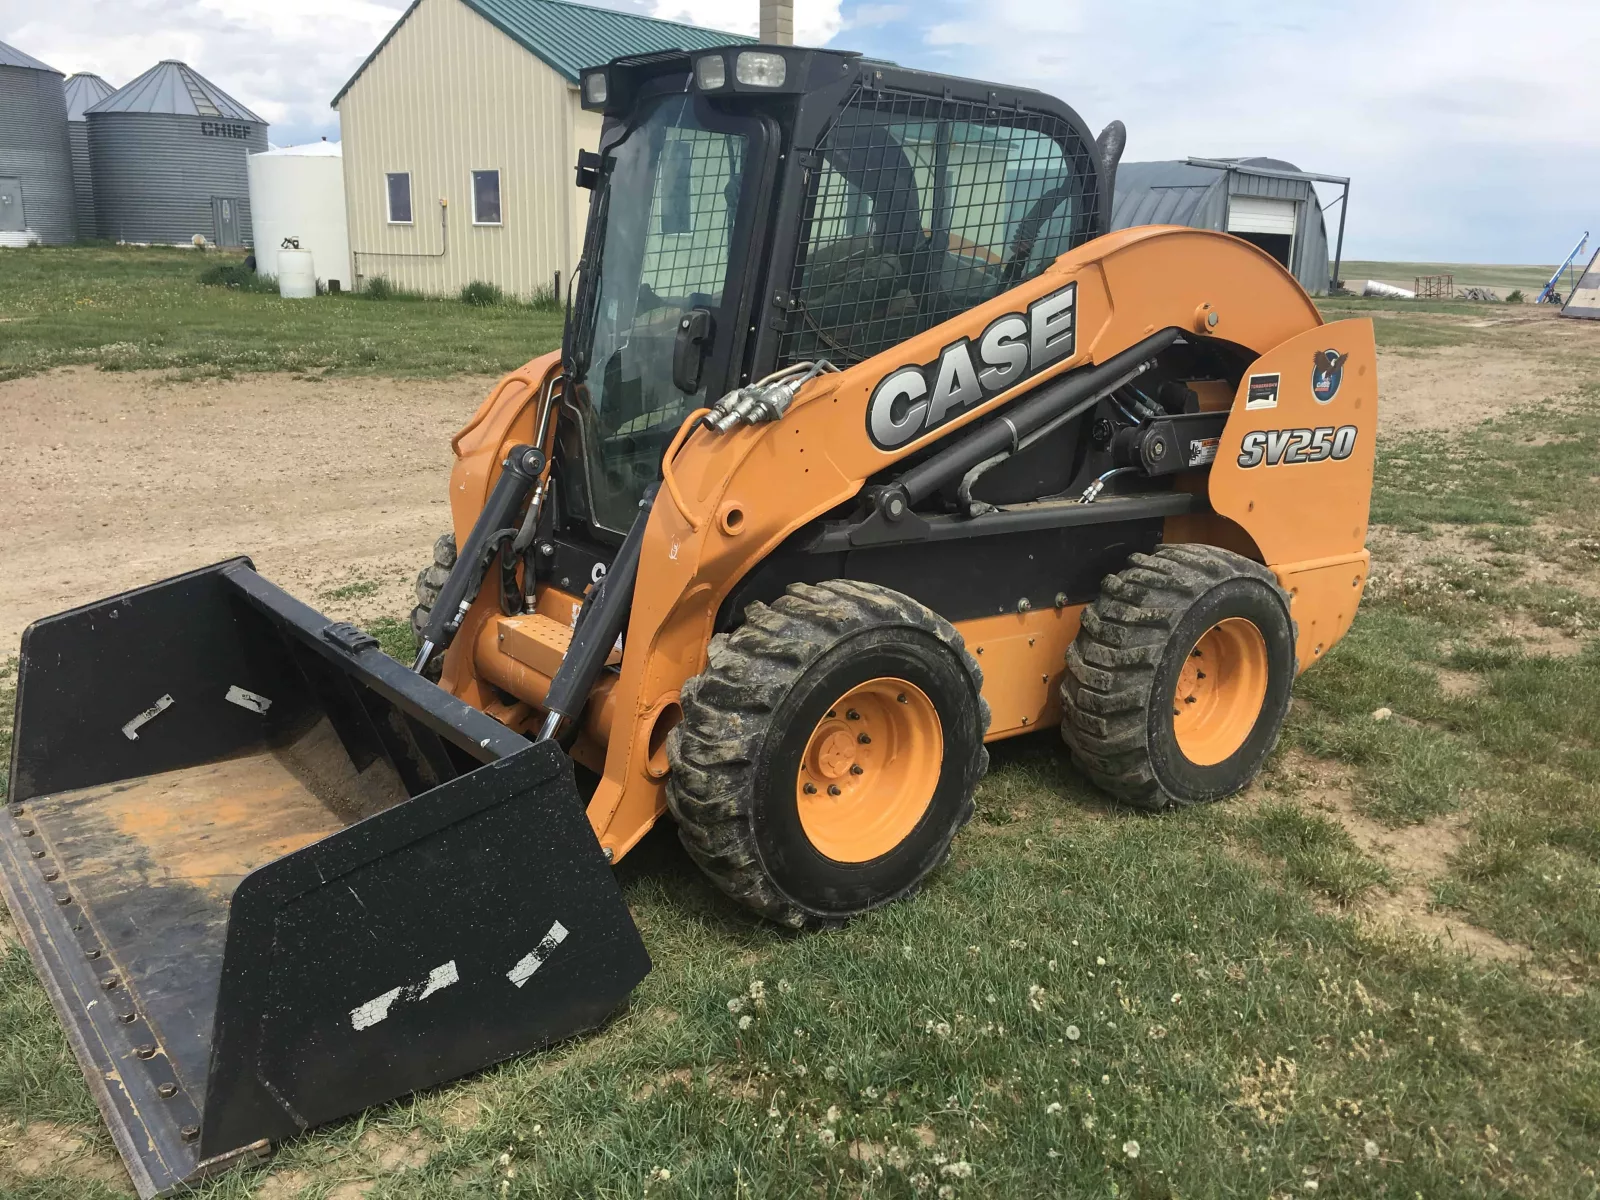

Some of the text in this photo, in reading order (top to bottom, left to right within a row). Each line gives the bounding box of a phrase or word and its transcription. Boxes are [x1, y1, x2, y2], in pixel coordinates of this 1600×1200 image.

[201, 121, 251, 139] CHIEF
[868, 284, 1075, 448] CASE
[1237, 425, 1358, 468] SV250
